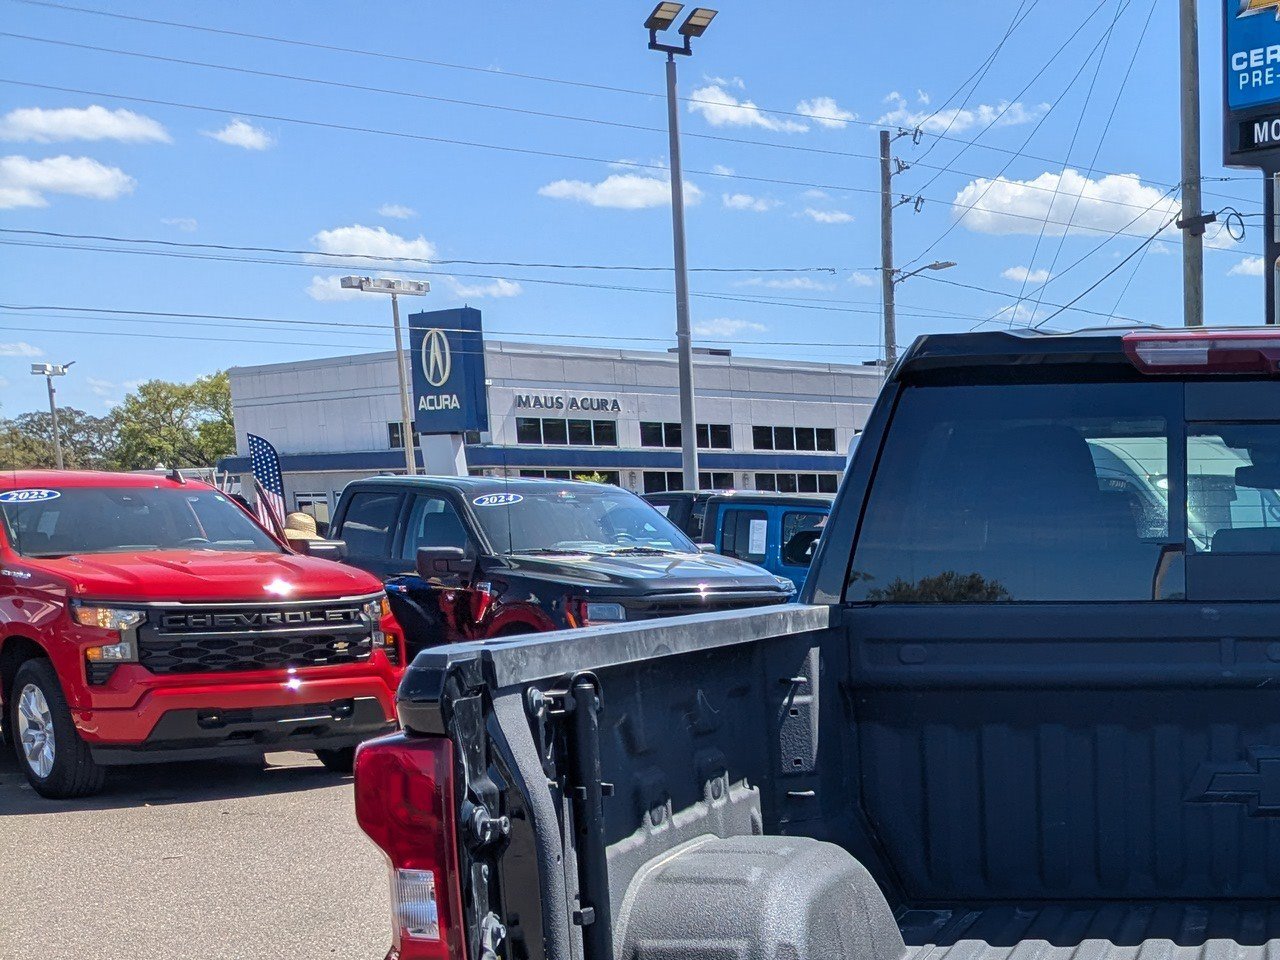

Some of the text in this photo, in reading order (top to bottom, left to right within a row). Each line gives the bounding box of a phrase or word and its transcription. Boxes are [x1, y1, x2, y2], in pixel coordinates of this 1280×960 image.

[418, 394, 460, 411] ACURA
[516, 394, 621, 412] MAUS ACURA
[8, 489, 48, 501] 2025
[483, 494, 515, 504] 2024
[162, 608, 361, 628] CHEVROLET
